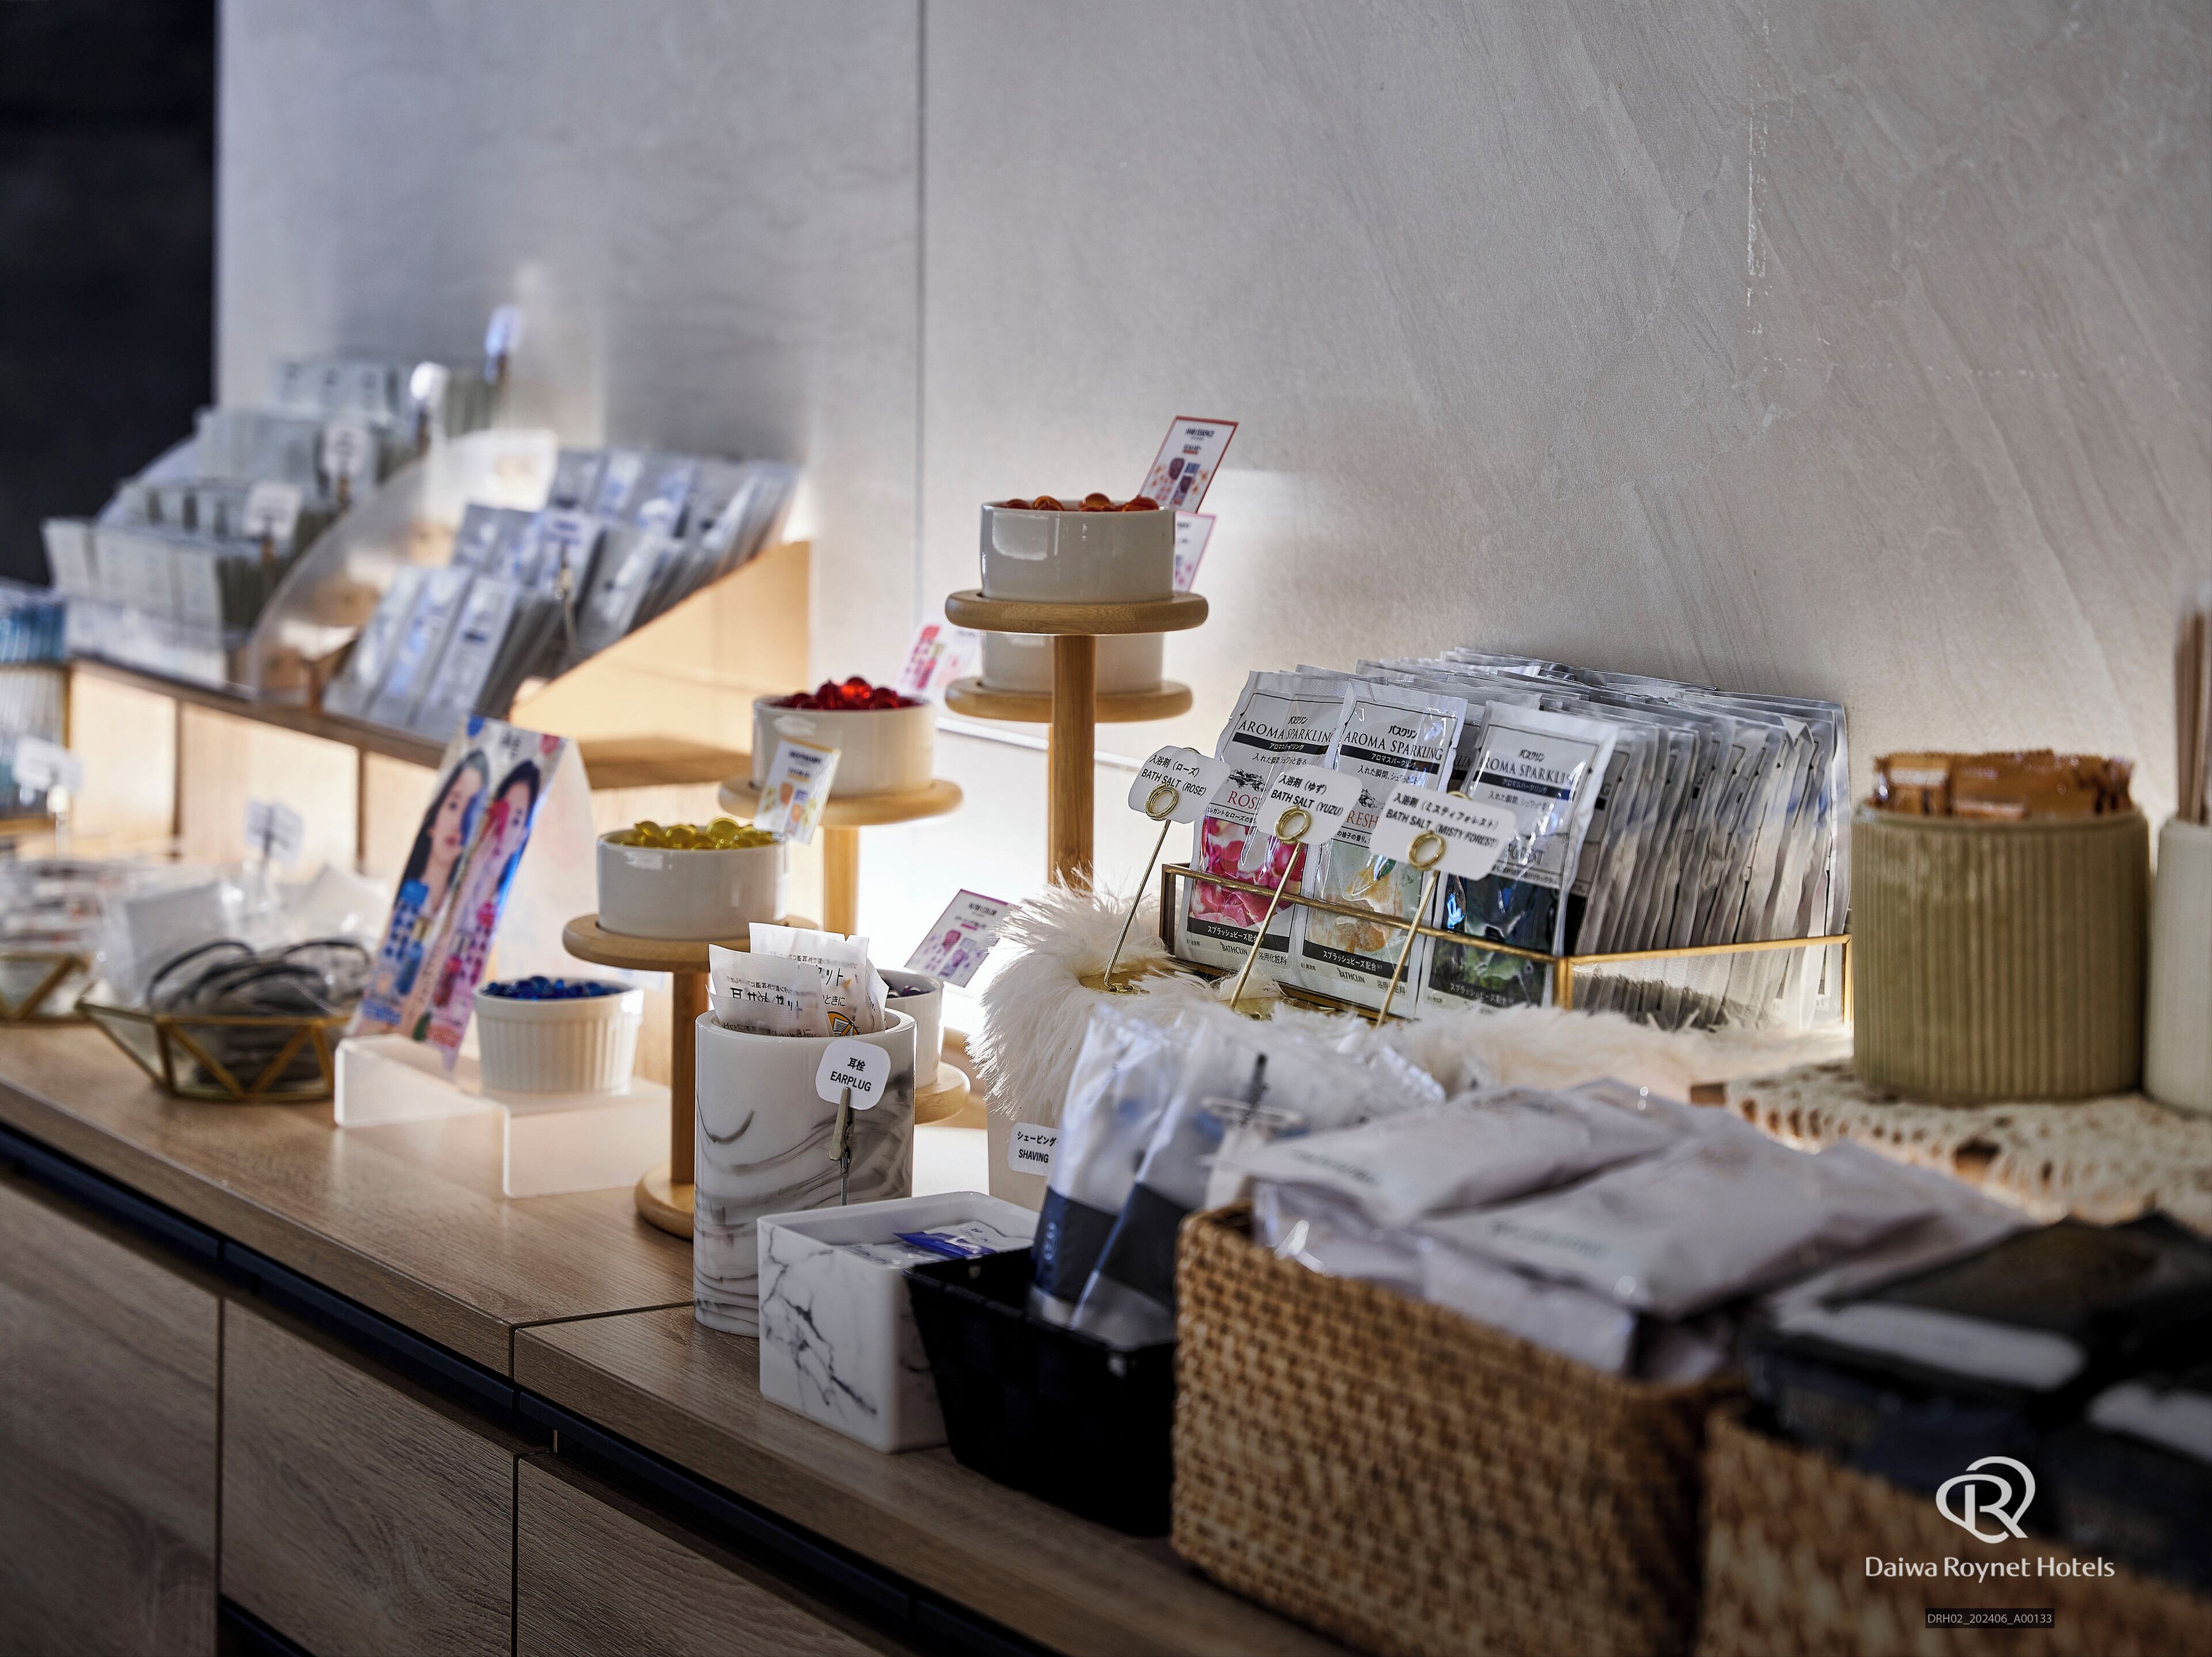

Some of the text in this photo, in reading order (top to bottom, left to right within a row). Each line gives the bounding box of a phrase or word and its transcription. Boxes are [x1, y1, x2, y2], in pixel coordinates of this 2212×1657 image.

[1238, 720, 1285, 740] AROMA
[1344, 731, 1444, 761] AROMA SPARKLING
[1149, 754, 1200, 778] 入浴剤（ローズ）
[1520, 764, 1577, 786] SPARKLIN
[1141, 768, 1206, 797] BATH SALT (ROSE)
[1278, 775, 1327, 795] 入浴剤（ゆず）
[1271, 789, 1344, 817] BATH SALT (YUZU)
[1346, 810, 1380, 829] RESH
[1386, 808, 1409, 824] BATH
[1410, 816, 1433, 830] SALT
[1219, 942, 1248, 956] BATHCLIN
[1337, 967, 1365, 984] BATHCLIN
[847, 1057, 866, 1071] 耳栓
[830, 1071, 872, 1092] EARPLUG
[1017, 1131, 1059, 1147] シェービング
[1018, 1148, 1049, 1163] SHAVING
